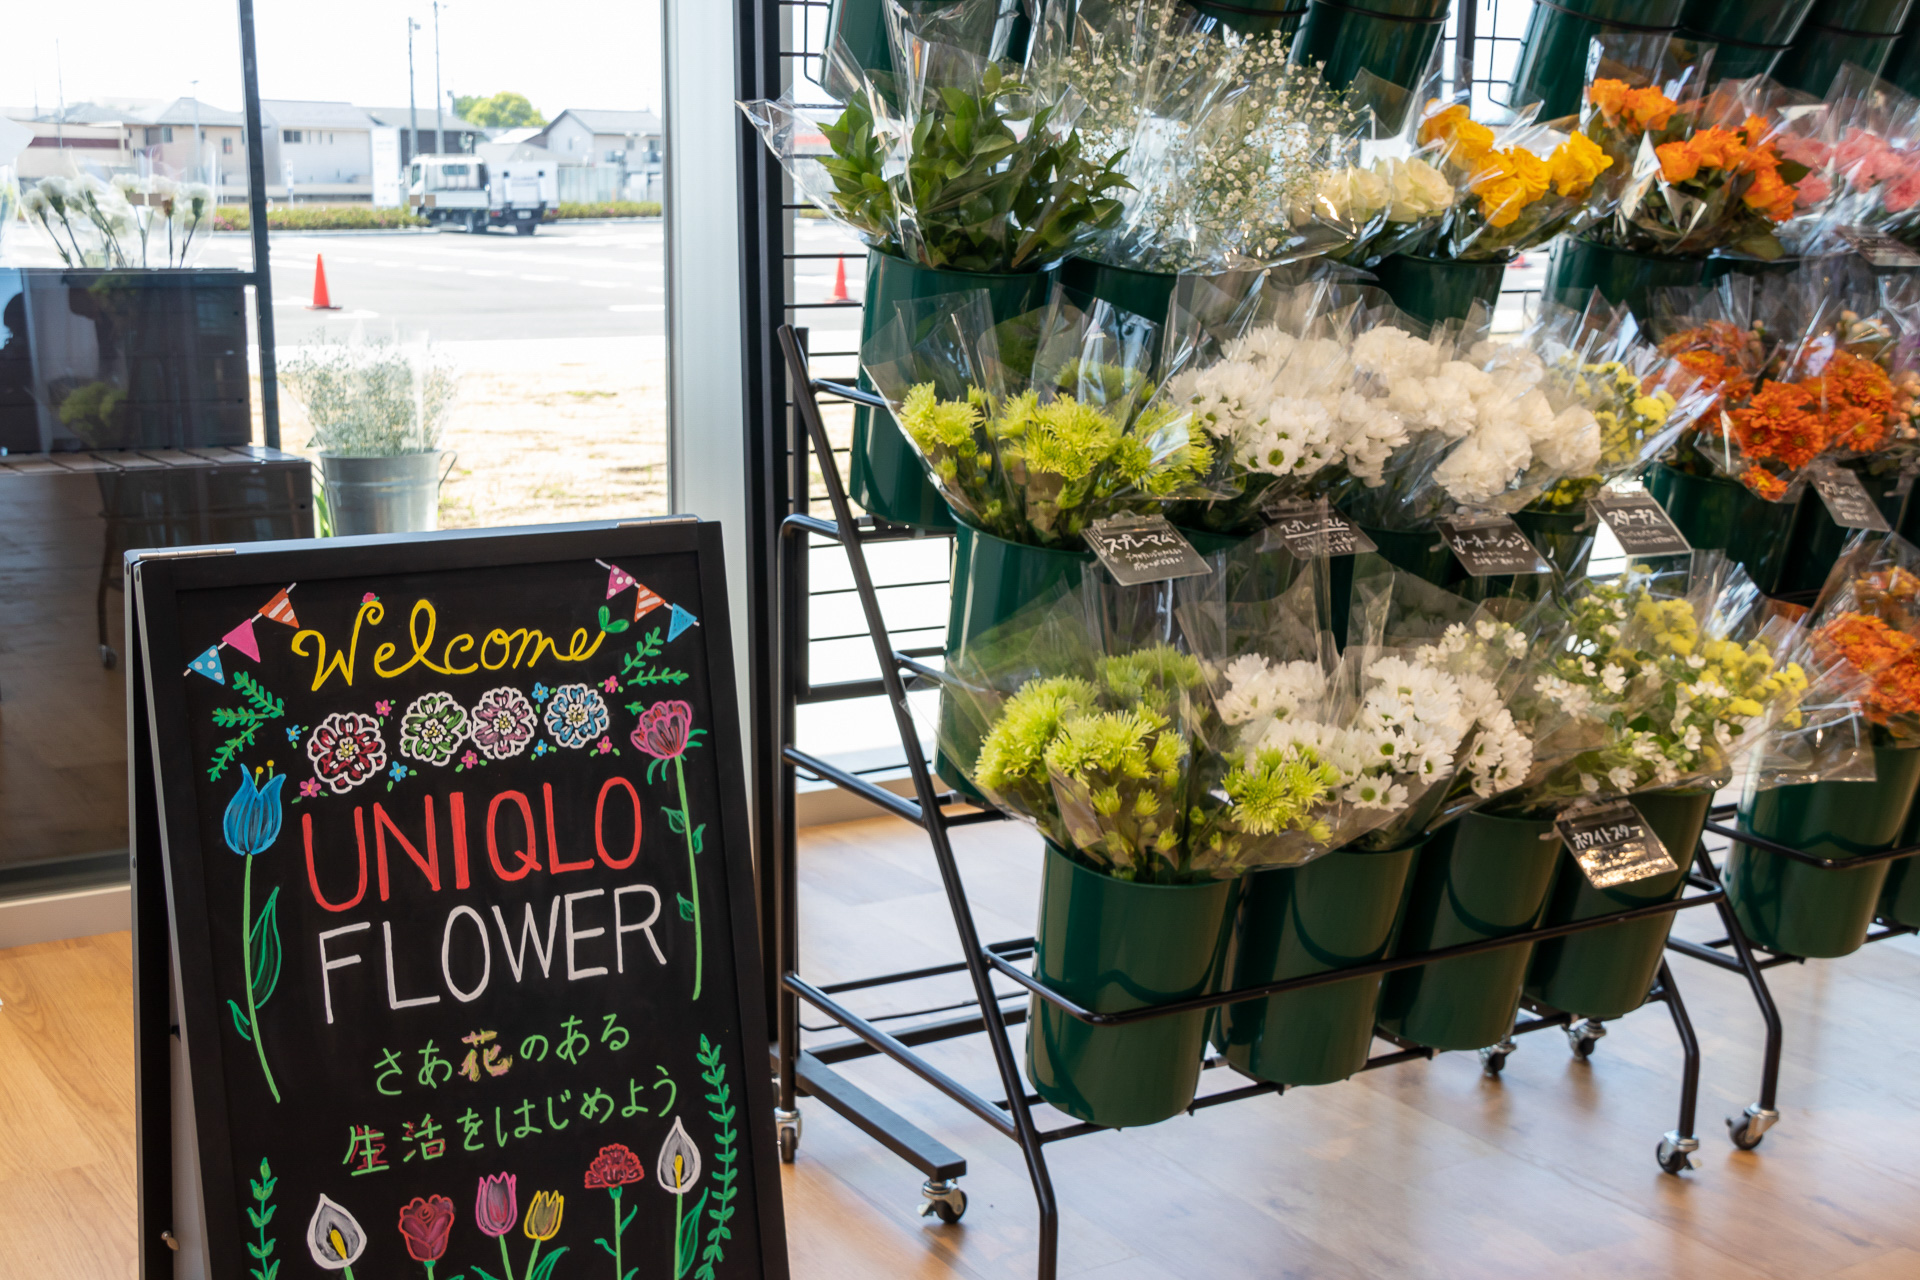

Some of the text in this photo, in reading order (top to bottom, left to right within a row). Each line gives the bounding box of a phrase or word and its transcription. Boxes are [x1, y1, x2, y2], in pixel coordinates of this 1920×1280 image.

[1103, 533, 1176, 553] スプレーマム
[1453, 535, 1522, 549] カーネーション
[1606, 509, 1662, 526] スターチス
[292, 599, 606, 691] Welcome
[302, 776, 643, 912] UNIQLO
[1572, 824, 1642, 849] ホワイトスター
[319, 884, 667, 1024] FLOWER
[374, 1013, 630, 1096] さあ花のある
[343, 1065, 677, 1176] 生活をはじめよう
